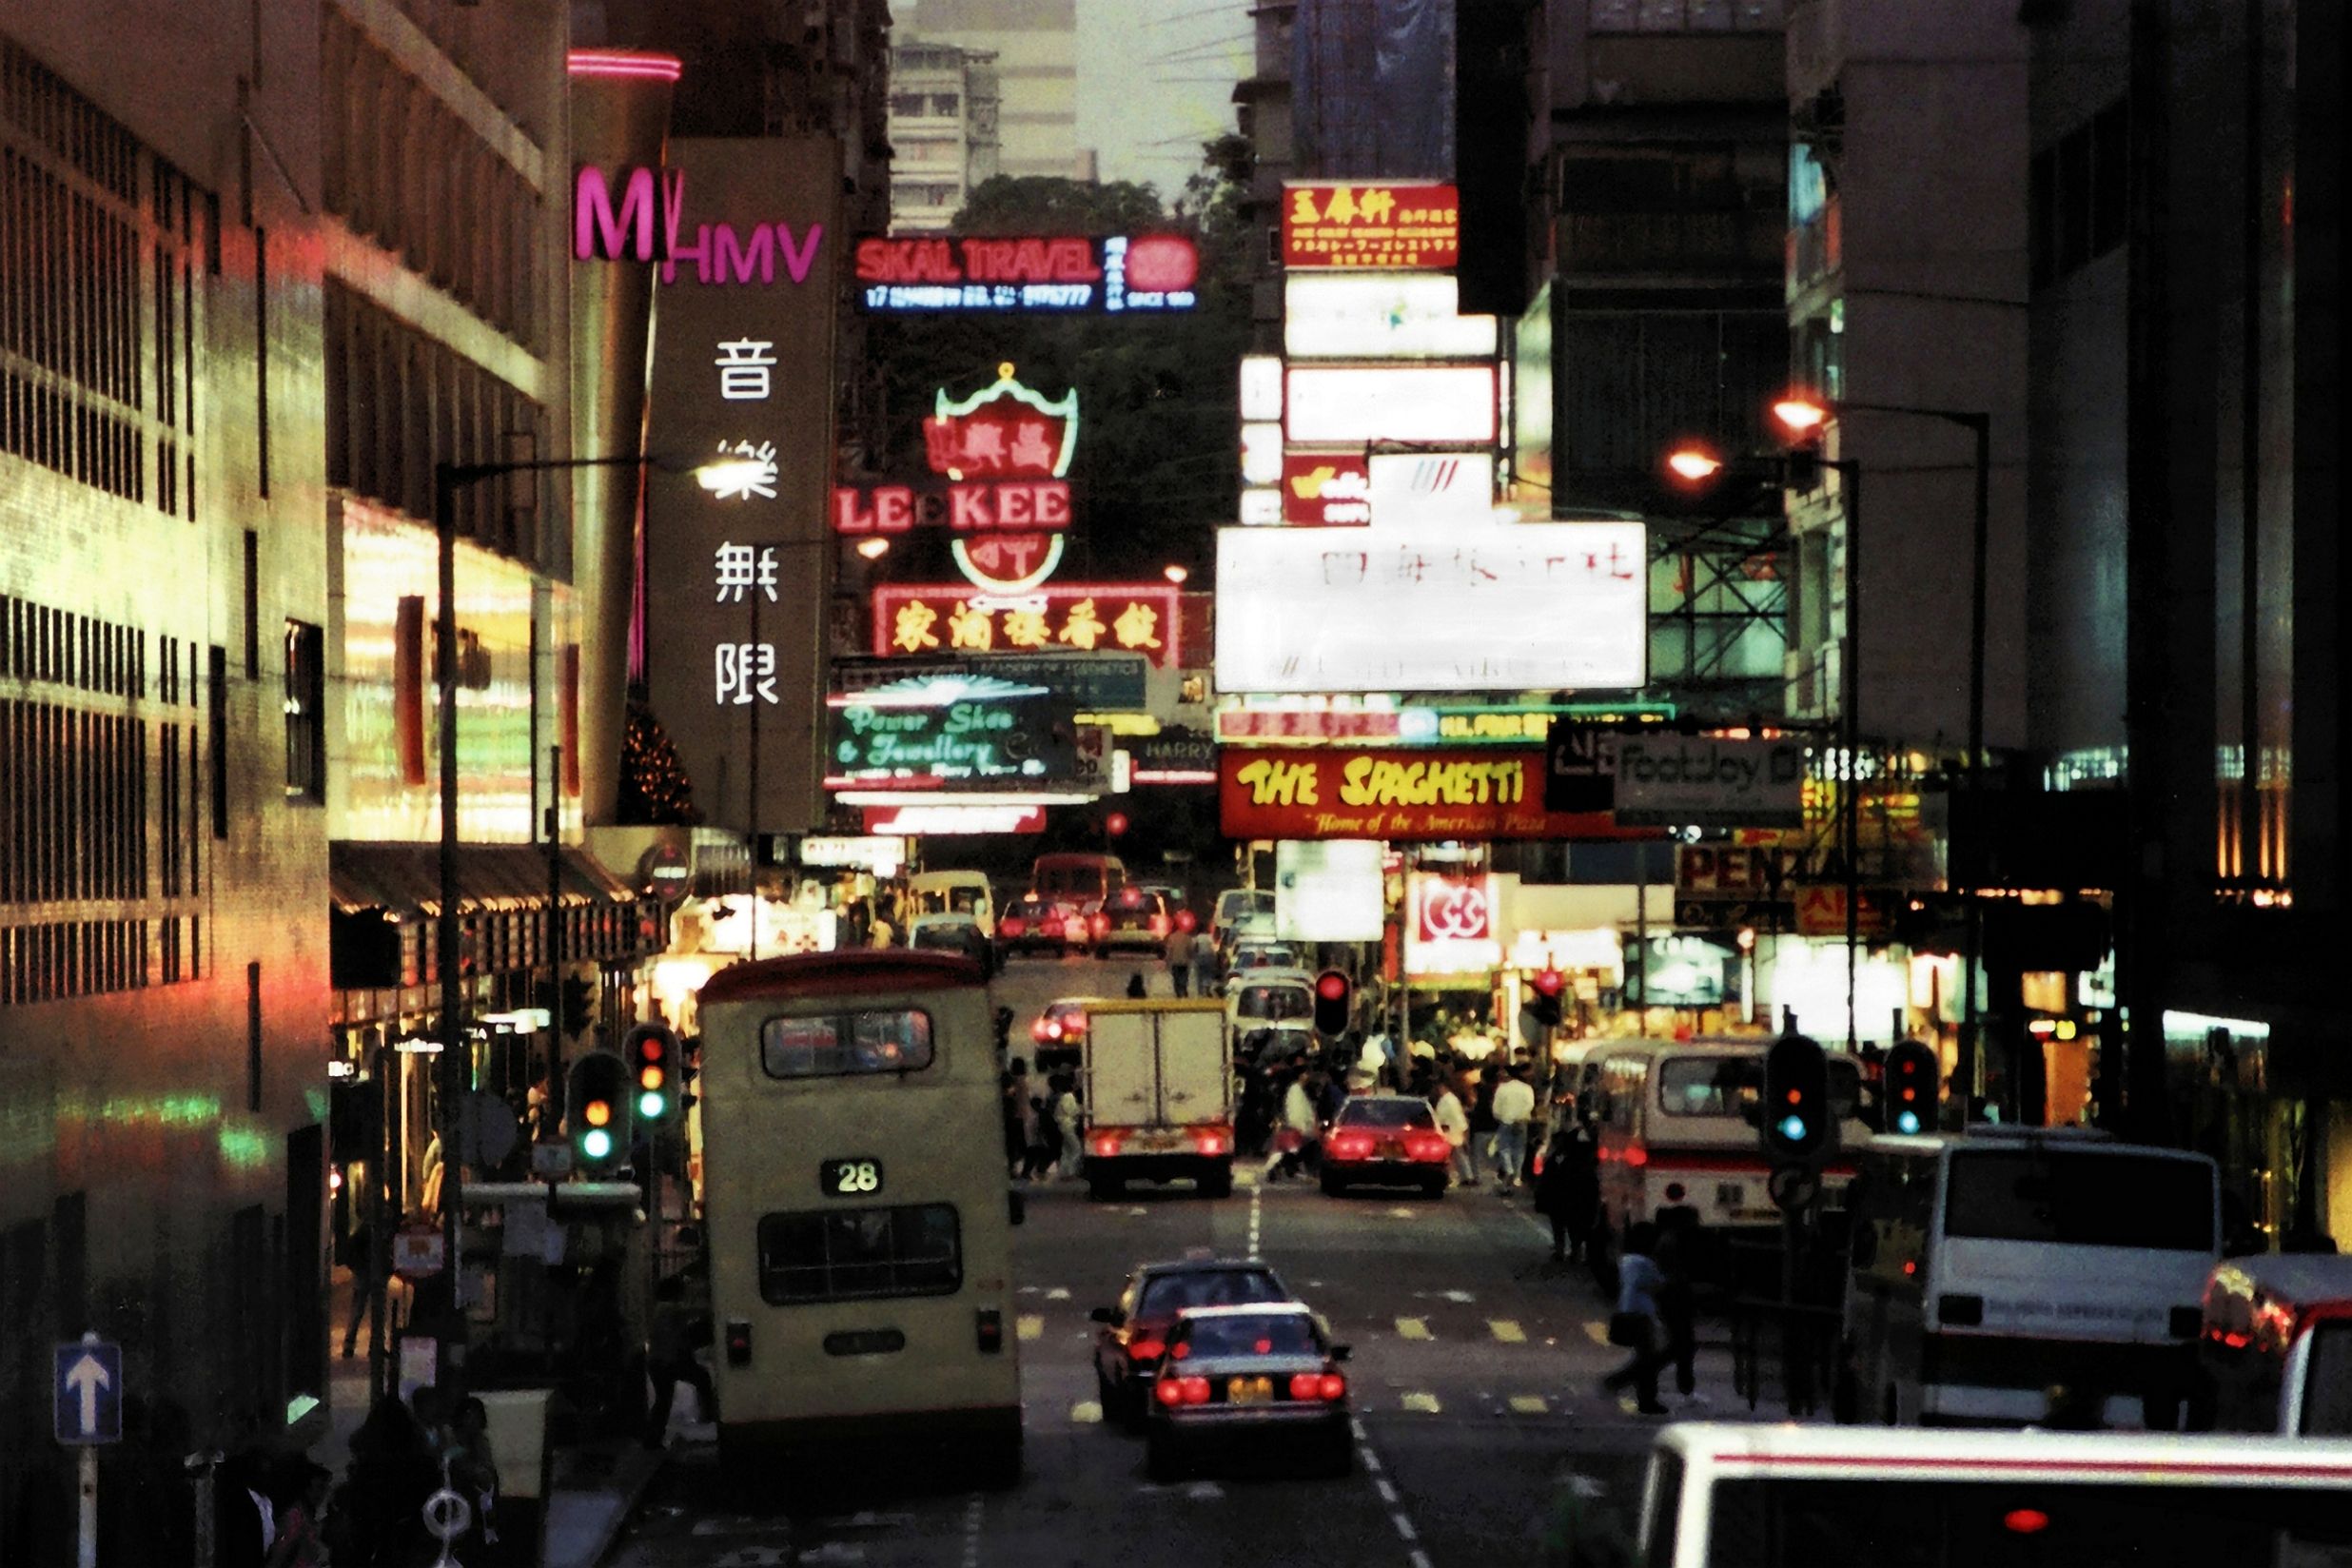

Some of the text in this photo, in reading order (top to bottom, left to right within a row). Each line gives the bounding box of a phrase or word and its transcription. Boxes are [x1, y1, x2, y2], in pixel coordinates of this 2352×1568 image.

[662, 222, 823, 284] HMV
[858, 238, 960, 282] SKAL
[963, 238, 1101, 281] TRAVEL
[950, 481, 1071, 528] KEE
[843, 703, 1013, 735] Power Shoe
[867, 734, 993, 770] Jewellery
[1237, 755, 1523, 806] THE SPAGHETTI
[1390, 813, 1413, 831] the
[838, 1163, 877, 1191] 28
